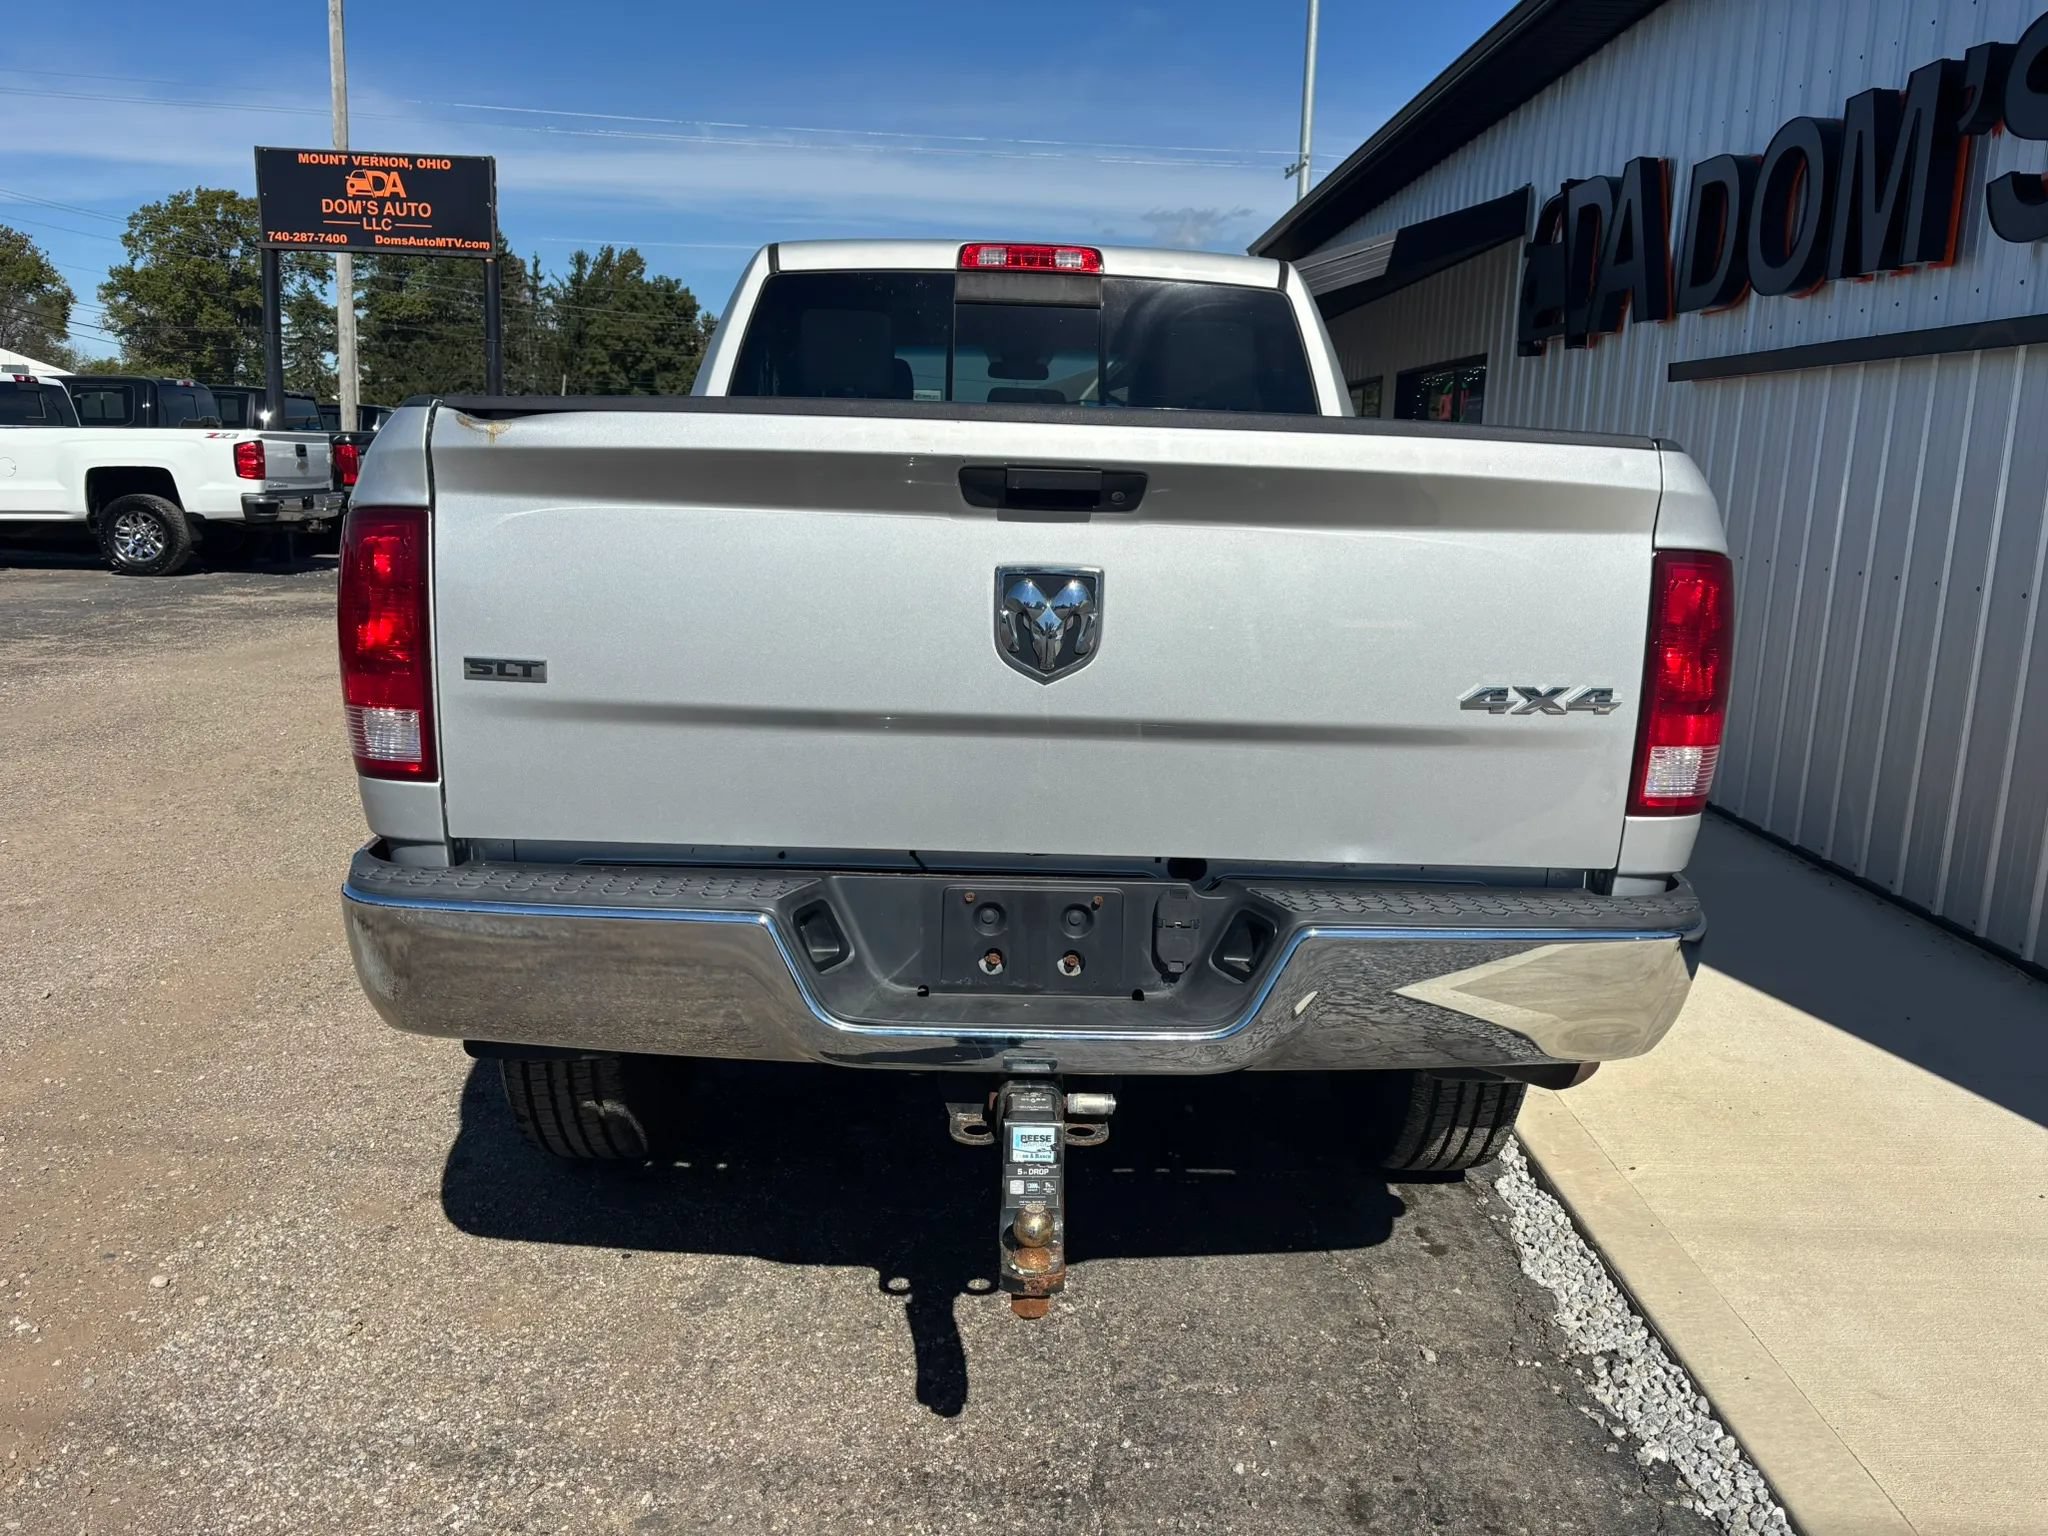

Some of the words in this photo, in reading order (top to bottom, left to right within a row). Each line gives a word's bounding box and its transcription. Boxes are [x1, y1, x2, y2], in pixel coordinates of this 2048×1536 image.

[297, 153, 348, 165] MOUNT
[352, 155, 412, 171] VERNON,
[416, 158, 452, 170] OHIO
[364, 169, 407, 198] DA
[321, 198, 379, 215] DOM'S
[383, 201, 432, 218] AUTO
[362, 217, 392, 231] LLC
[267, 231, 348, 244] 740-287-7400
[374, 234, 491, 250] DomsAutoMTV.com
[467, 659, 545, 680] SLT
